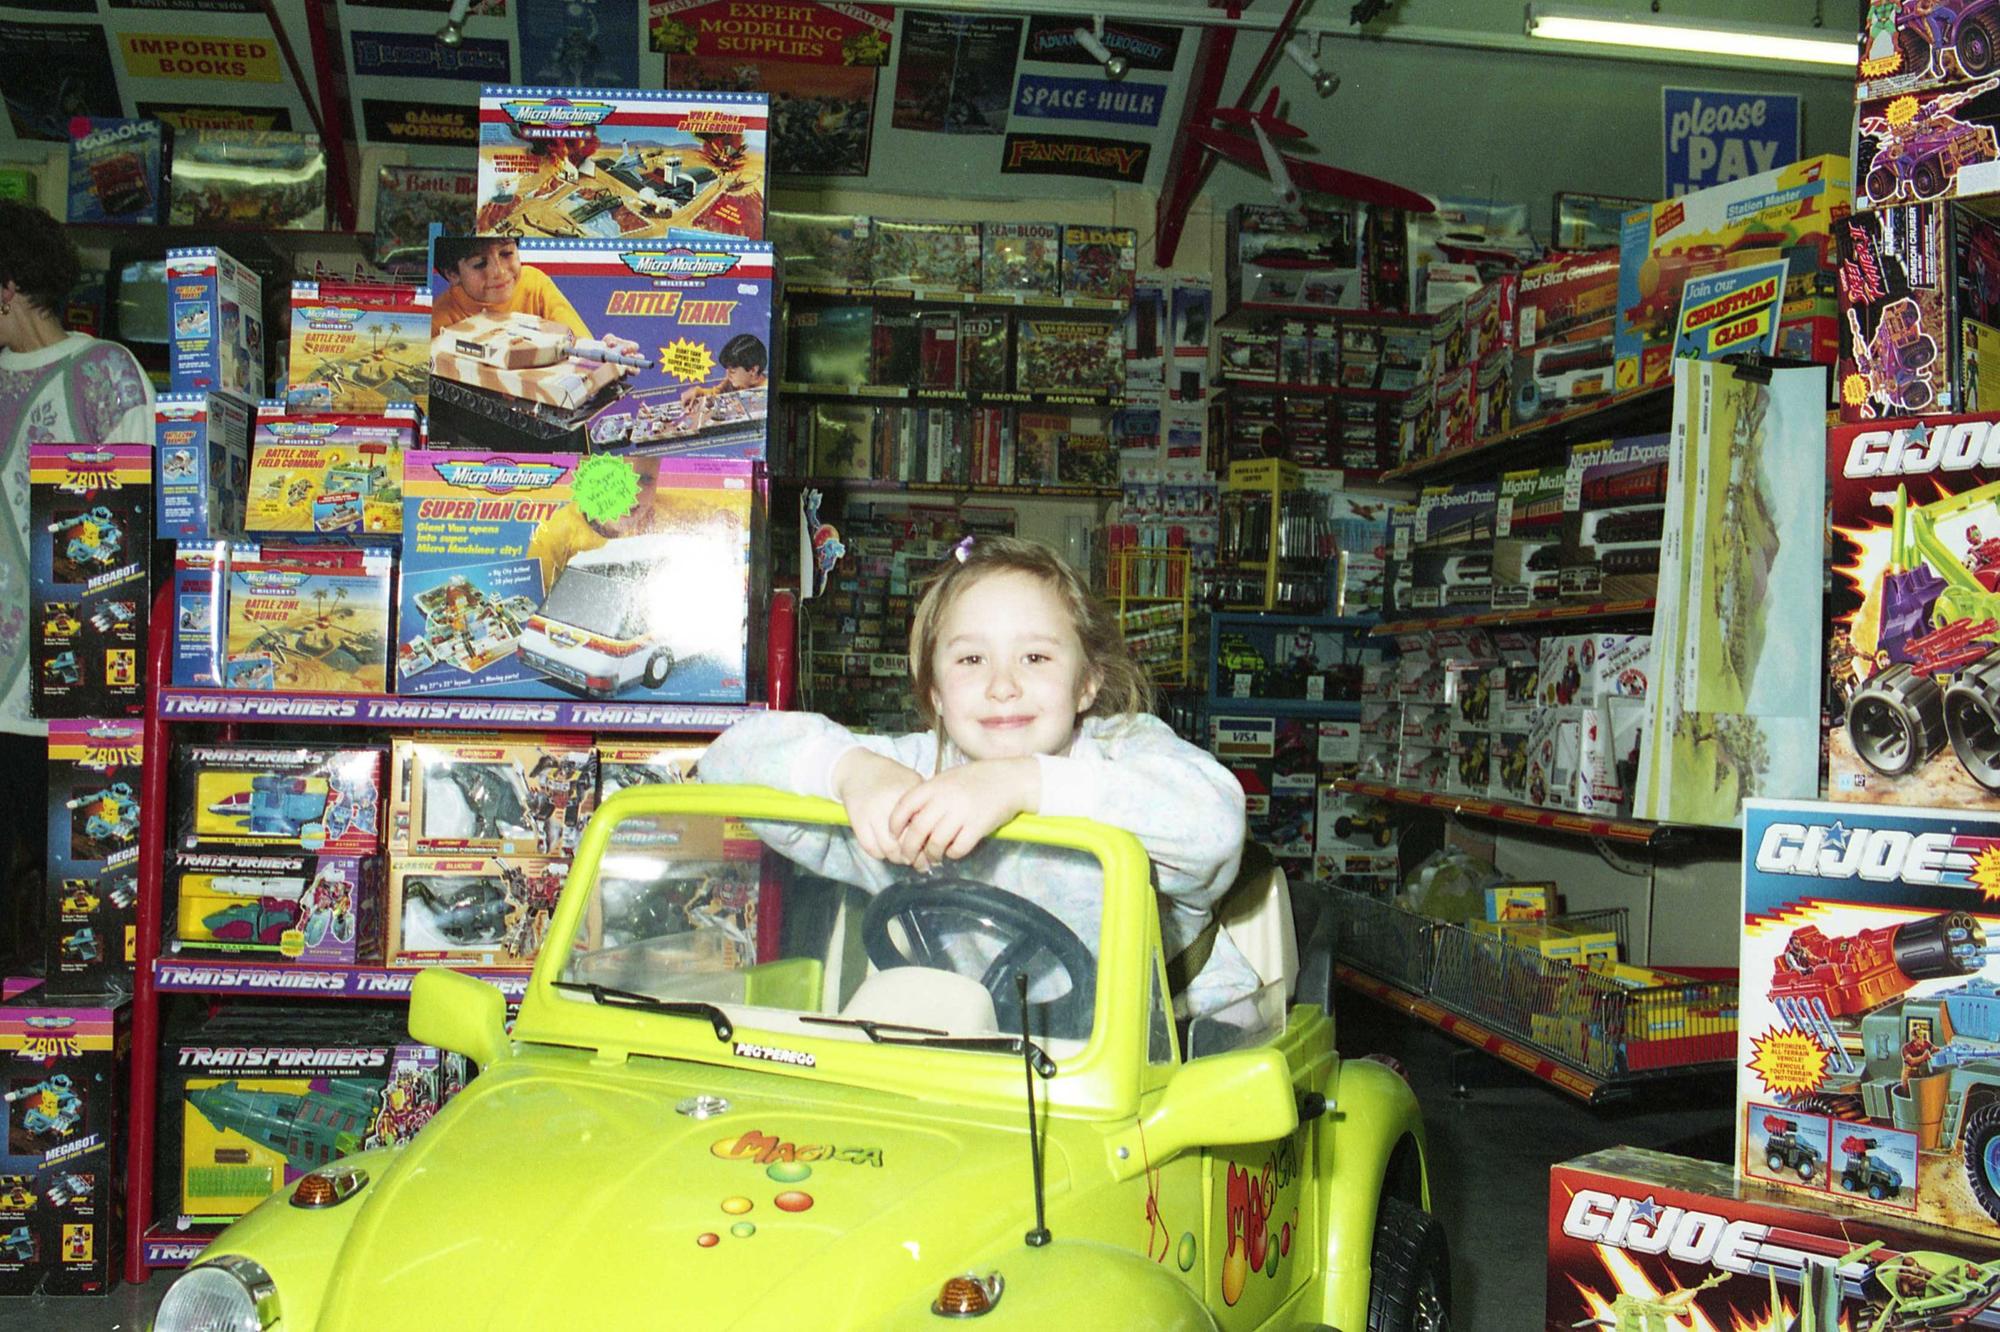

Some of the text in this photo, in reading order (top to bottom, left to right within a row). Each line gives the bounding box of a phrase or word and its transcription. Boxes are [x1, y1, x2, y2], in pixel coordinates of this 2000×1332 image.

[729, 3, 816, 22] EXPERT
[700, 18, 843, 41] MODELLING
[130, 39, 267, 60] IMPORTED
[717, 37, 824, 57] SUPPLIES
[159, 59, 247, 76] BOOKS
[405, 110, 466, 128] GAMES
[678, 121, 746, 132] BATTLEGROUND
[1670, 98, 1766, 152] please
[386, 121, 479, 141] WORKSHO
[532, 129, 585, 138] MILITARY
[1007, 139, 1144, 175] FANTASY
[1688, 137, 1779, 181] PAY
[1728, 201, 1764, 218] Station
[1764, 190, 1801, 209] Master
[1760, 206, 1783, 222] Train
[1909, 207, 1917, 244] CRUISER
[1519, 275, 1540, 292] Red
[1543, 269, 1566, 287] Star
[1857, 240, 1885, 301] FIGHTER
[1687, 278, 1736, 300] Join our
[1845, 258, 1869, 304] STREET
[606, 291, 683, 317] BATTLE
[678, 300, 738, 325] TANK
[1685, 279, 1776, 329] CHRISTMAS
[304, 333, 356, 344] BATTLE ZONE
[1714, 317, 1759, 346] CLUB
[313, 344, 347, 353] BUNKER
[264, 448, 320, 459] BATTLE ZONE
[1571, 441, 1671, 470] Night Mail Expres
[257, 459, 326, 469] FIELD COMMAND
[1501, 479, 1537, 496] Mighty
[1440, 492, 1470, 510] Speed
[1470, 489, 1496, 504] Train
[418, 499, 559, 522] SUPER VAN CITY
[416, 522, 499, 536] Giant Van opens
[416, 534, 469, 545] into super
[416, 544, 523, 557] Micro Machines city!
[88, 564, 138, 589] MEGABOT
[245, 599, 300, 610] BATTLE ZONE
[253, 611, 289, 621] BUNKER
[164, 695, 358, 717] TRANSFORMERS
[367, 699, 558, 722] TRANSFORMERS
[1232, 731, 1258, 743] VISA
[191, 748, 323, 765] TRANSFORMERS
[107, 847, 139, 866] MEGA
[176, 853, 305, 870] TRANSFORMERS
[160, 966, 348, 990] TRANSFORMERS
[178, 1047, 388, 1066] TRANSFORMERS
[45, 1135, 97, 1162] MEGABOT
[730, 1130, 884, 1168] MAGICA
